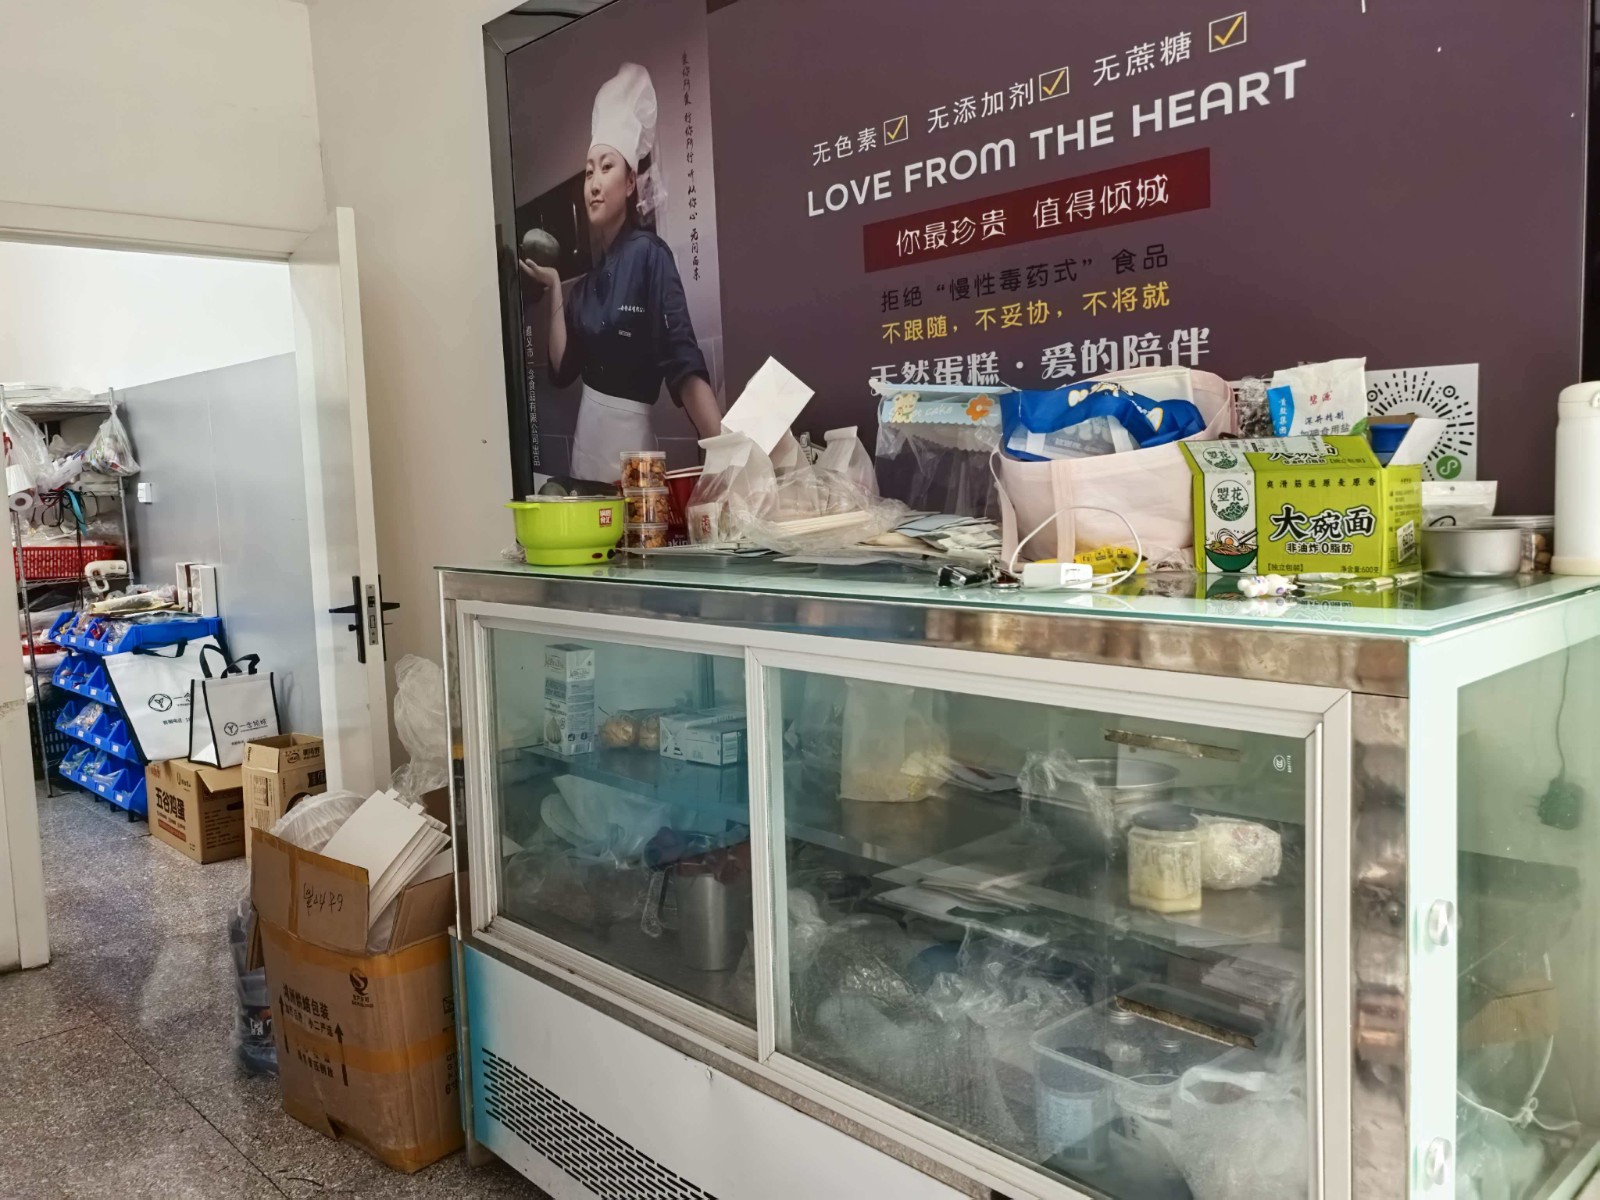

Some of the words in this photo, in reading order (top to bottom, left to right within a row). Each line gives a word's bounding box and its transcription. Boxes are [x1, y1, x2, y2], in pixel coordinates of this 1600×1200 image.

[807, 171, 893, 217] LOVE
[904, 138, 1016, 193] FROM
[1030, 111, 1115, 161] THE
[1132, 59, 1307, 138] HEART
[812, 127, 877, 166] 无色素
[927, 79, 1034, 133] 无添加剂
[1093, 31, 1192, 86] 无蔗糖
[895, 209, 1008, 257] 你最珍贵
[1033, 173, 1169, 230] 值得倾城
[1269, 504, 1376, 542] 大碗面
[155, 787, 185, 821] 五谷鸡蛋
